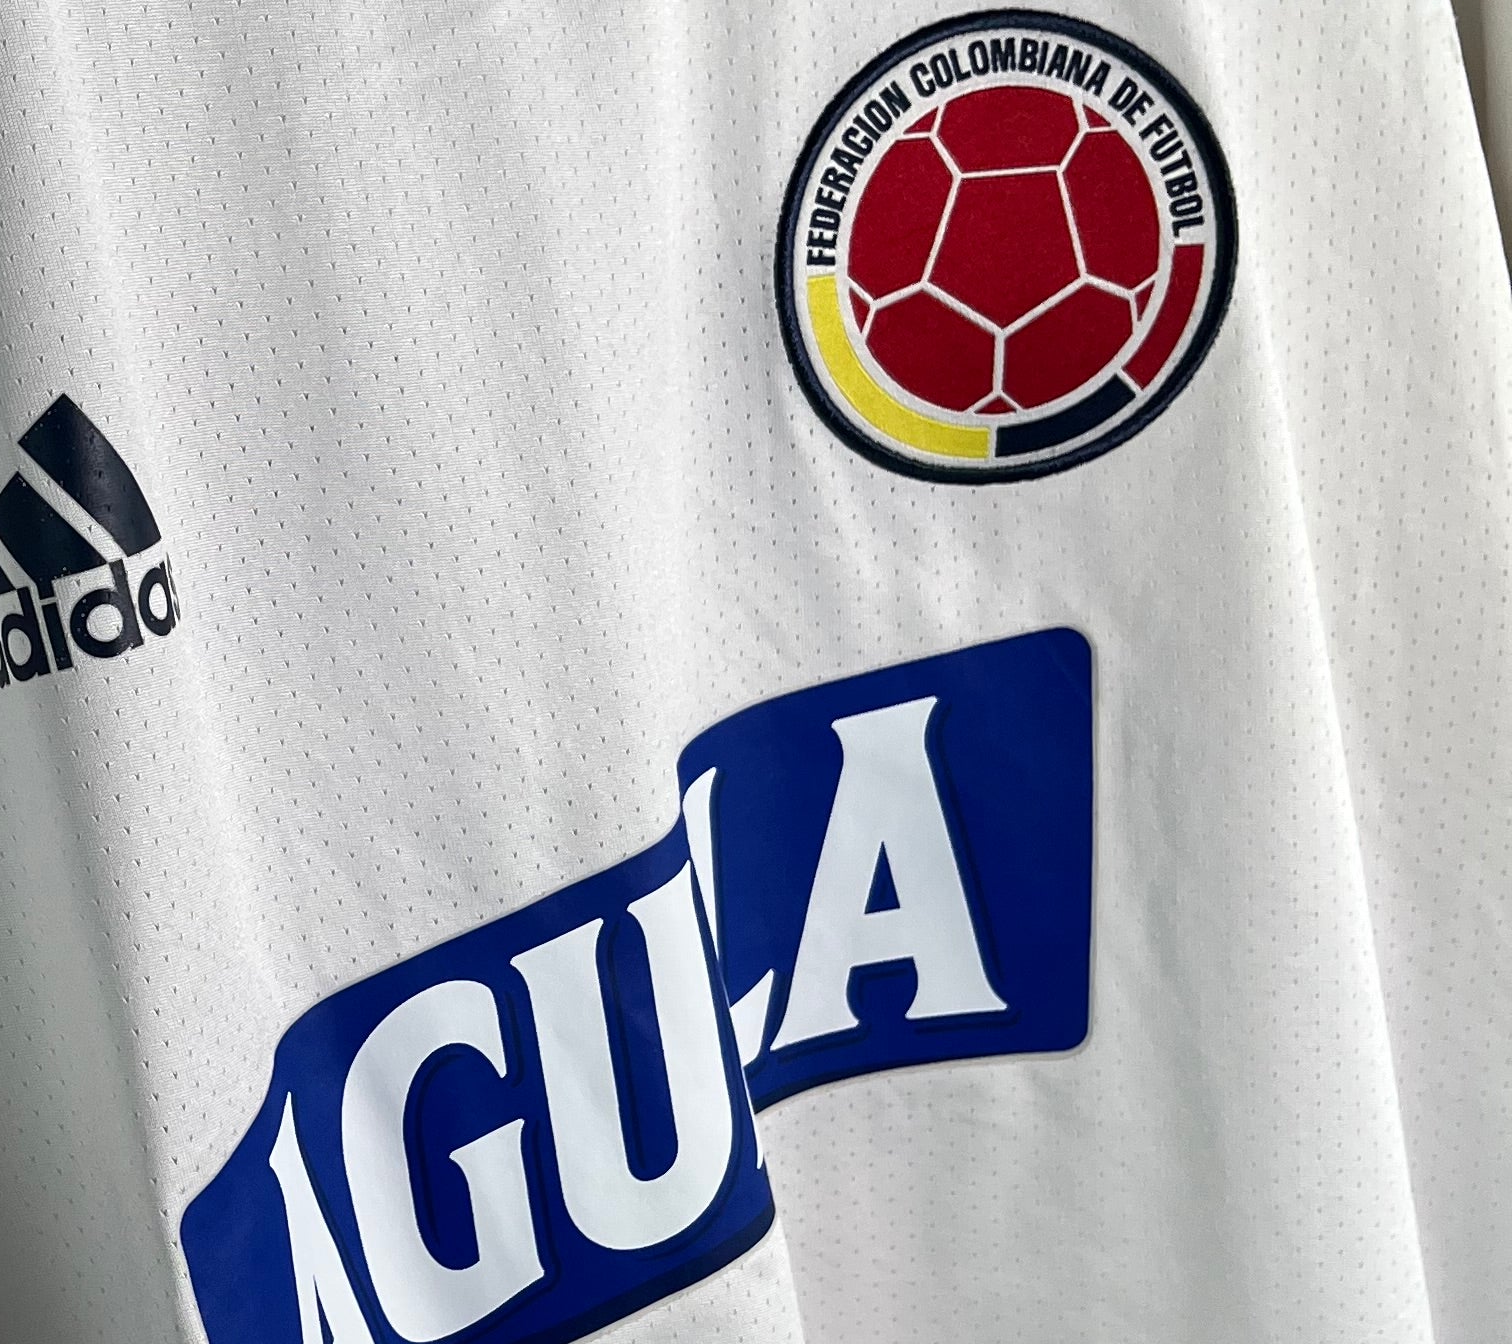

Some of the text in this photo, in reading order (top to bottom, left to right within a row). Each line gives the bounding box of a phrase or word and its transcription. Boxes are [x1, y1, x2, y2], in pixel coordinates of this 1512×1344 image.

[806, 37, 1205, 266] FEDERACION COLOMBIANA DE FUTBOL
